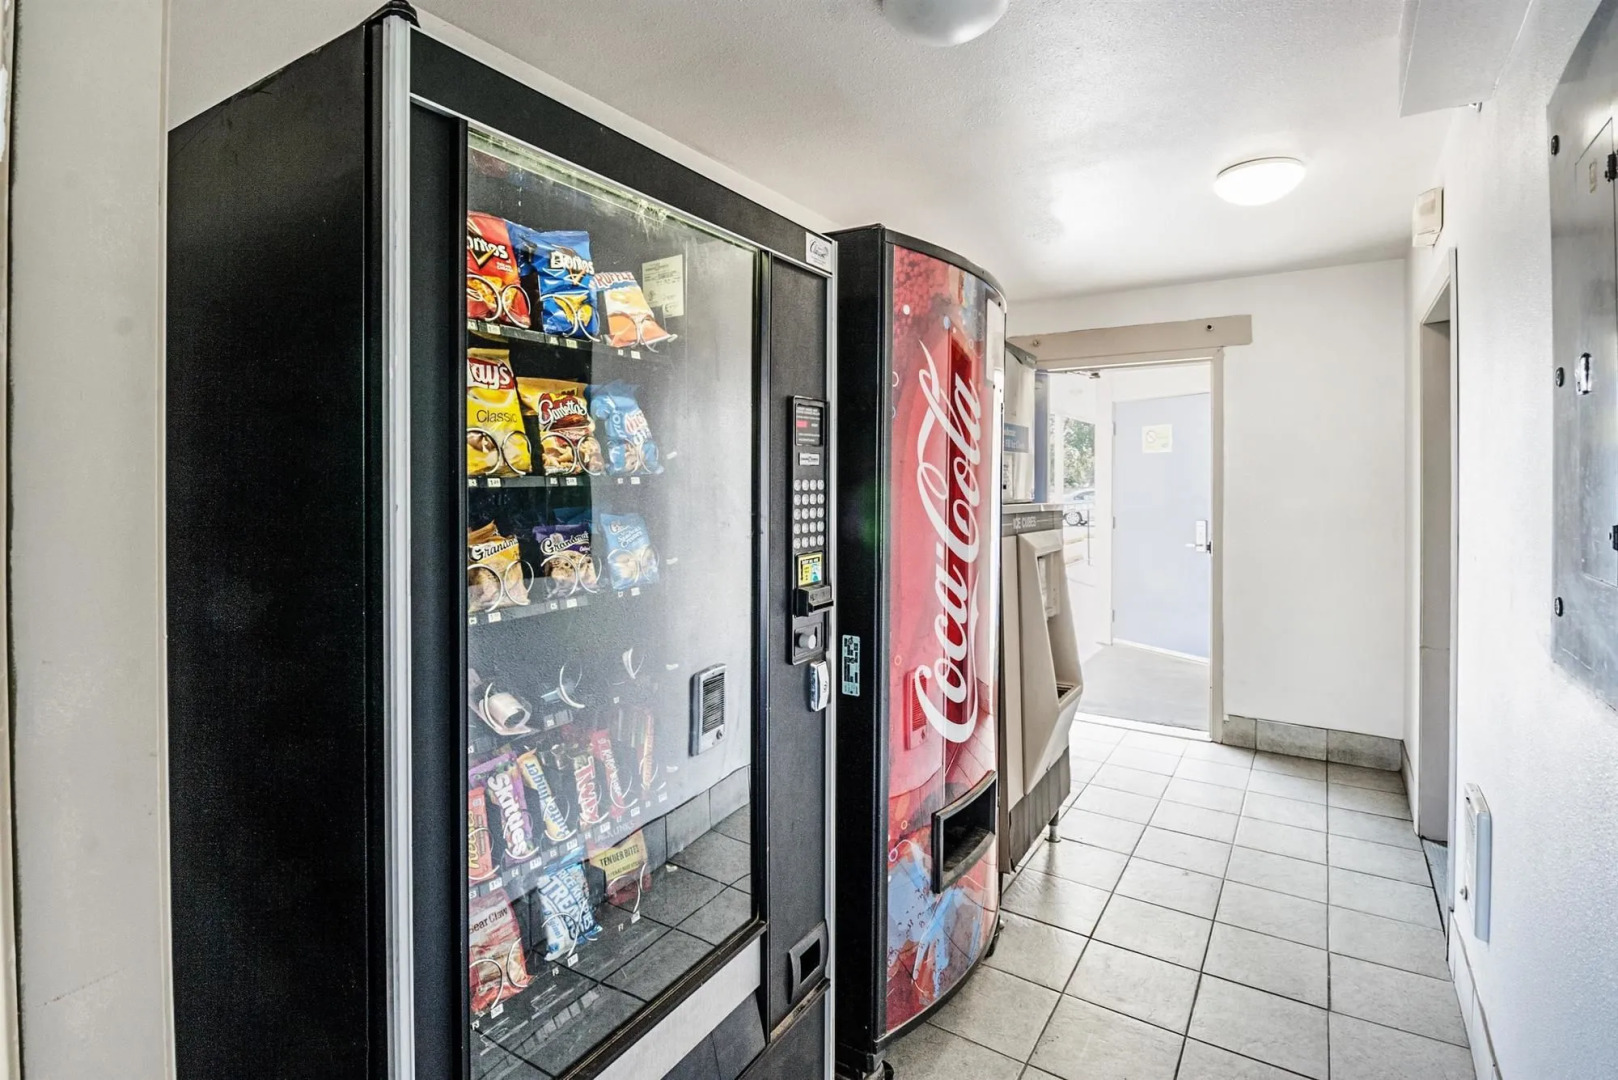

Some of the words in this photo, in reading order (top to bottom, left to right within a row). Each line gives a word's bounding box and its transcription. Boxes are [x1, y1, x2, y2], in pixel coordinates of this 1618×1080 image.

[467, 236, 509, 260] oritos
[594, 272, 634, 288] RUFFLE
[476, 409, 518, 424] Classic
[1012, 517, 1021, 529] ICE
[1021, 515, 1037, 528] CUBES
[915, 340, 982, 744] Coca-Cola
[488, 905, 509, 924] Claw
